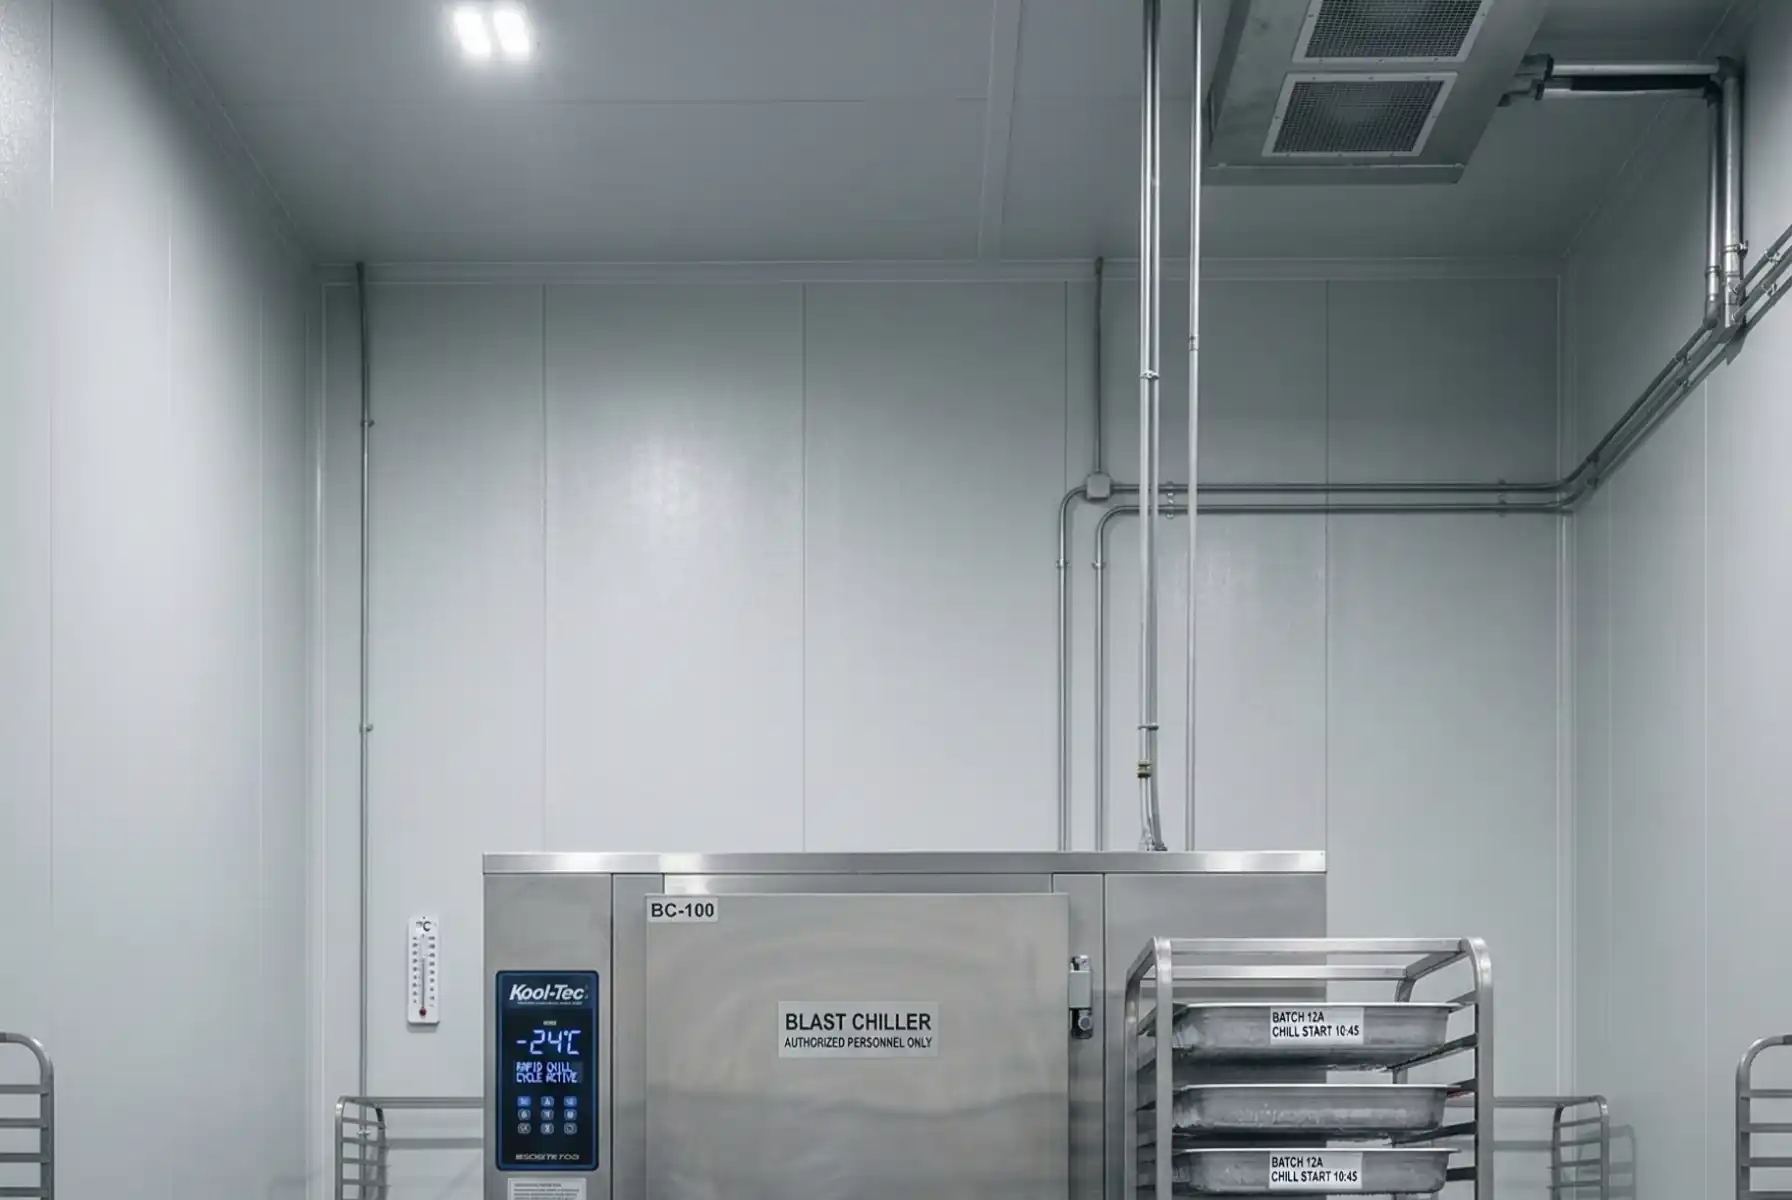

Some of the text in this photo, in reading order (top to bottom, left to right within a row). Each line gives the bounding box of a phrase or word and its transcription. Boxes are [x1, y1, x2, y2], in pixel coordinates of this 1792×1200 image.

[651, 903, 715, 918] BC-100
[509, 984, 585, 1001] Kool-Tec
[785, 1013, 932, 1031] BLAST CHILLER
[1272, 1011, 1325, 1023] BATCH 12A
[1272, 1025, 1360, 1037] CHILL START 10:45
[784, 1037, 933, 1048] AUTHORIZED PERSONNEL ONLY
[1271, 1157, 1324, 1168] BATCH 12A
[1271, 1171, 1358, 1182] CHILL START 10:45
